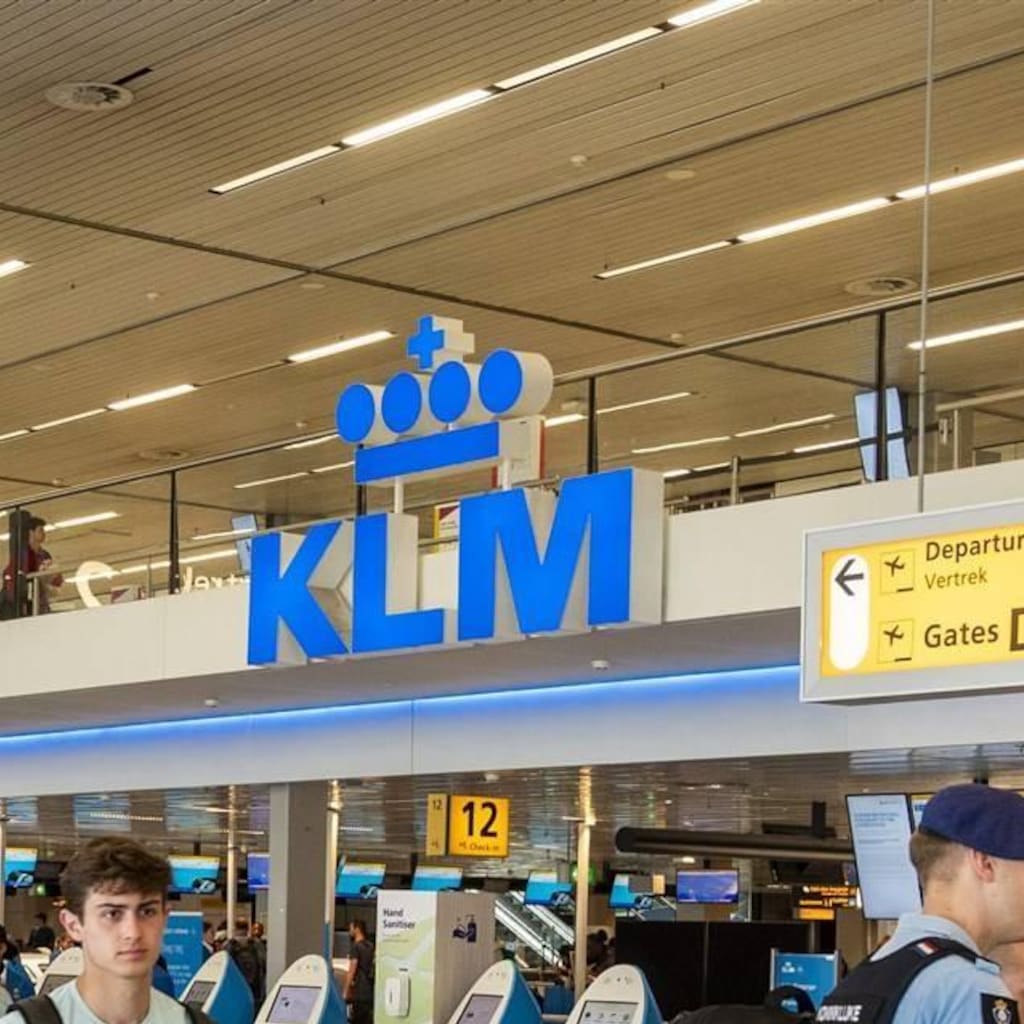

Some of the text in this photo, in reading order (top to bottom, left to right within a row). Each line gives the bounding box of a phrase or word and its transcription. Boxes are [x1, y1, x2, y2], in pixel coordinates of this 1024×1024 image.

[247, 467, 634, 667] KLM
[924, 567, 988, 590] Vertrek
[923, 623, 999, 649] Gates
[462, 801, 498, 838] 12
[383, 907, 404, 918] Hand
[383, 919, 416, 930] Sanitiser
